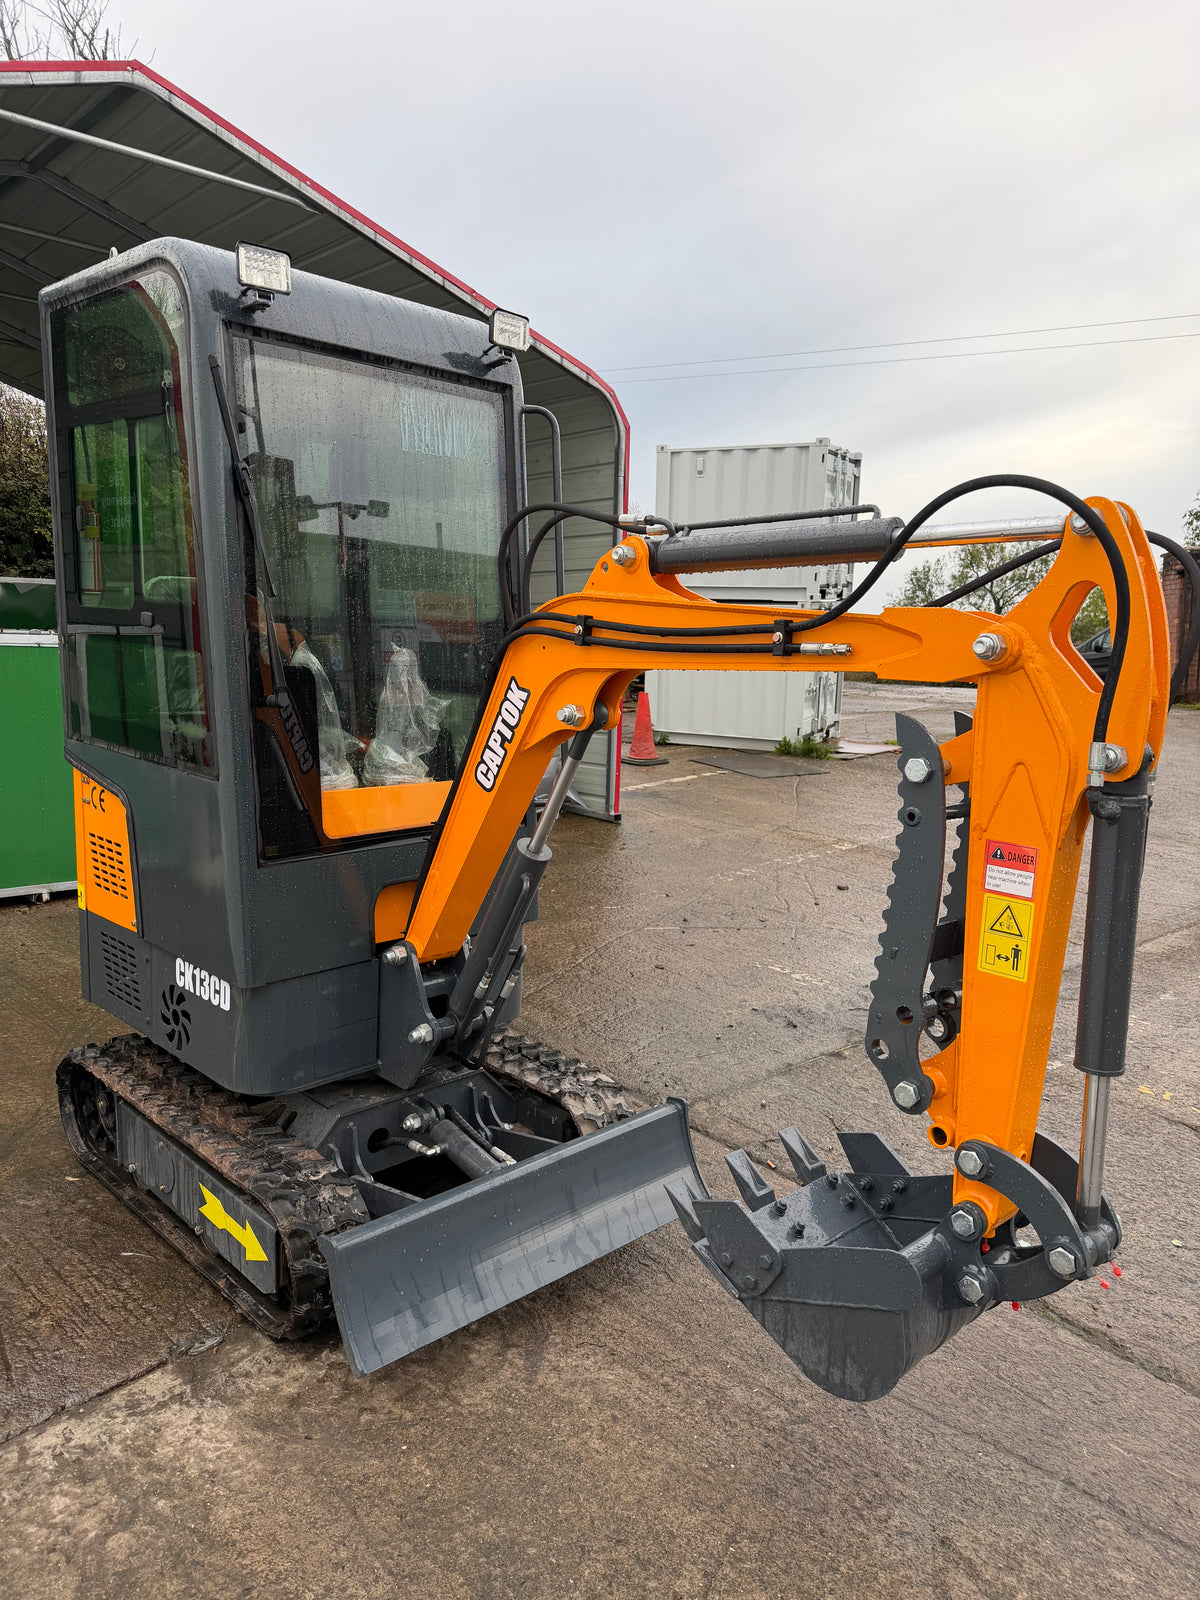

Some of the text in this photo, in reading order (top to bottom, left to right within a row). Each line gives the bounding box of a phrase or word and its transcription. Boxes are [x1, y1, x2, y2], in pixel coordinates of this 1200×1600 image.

[475, 678, 529, 790] CAPTOK
[1008, 852, 1034, 865] DANGER
[175, 957, 231, 1011] CK13CD
